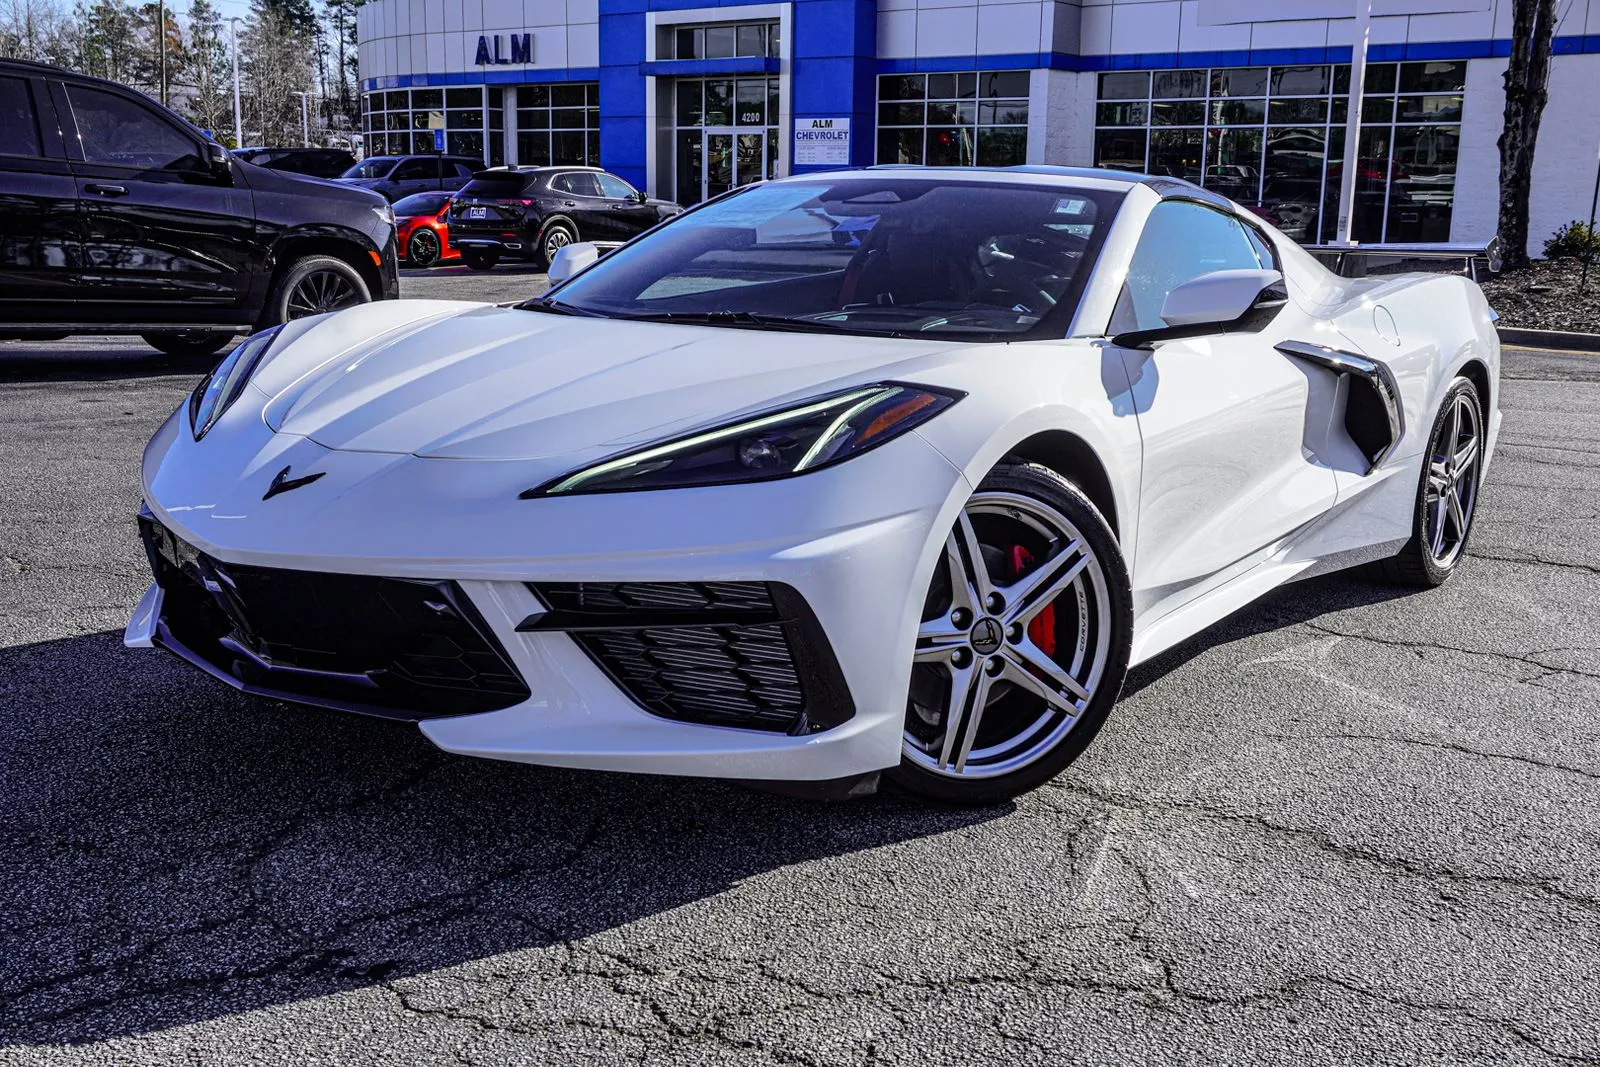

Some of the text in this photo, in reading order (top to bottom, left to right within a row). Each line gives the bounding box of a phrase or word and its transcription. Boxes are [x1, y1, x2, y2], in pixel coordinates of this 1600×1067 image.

[475, 33, 533, 65] ALM
[742, 112, 760, 122] 4200
[812, 120, 833, 128] ALM
[796, 131, 849, 140] CHEVROLET
[1079, 591, 1087, 652] CORVETTE
